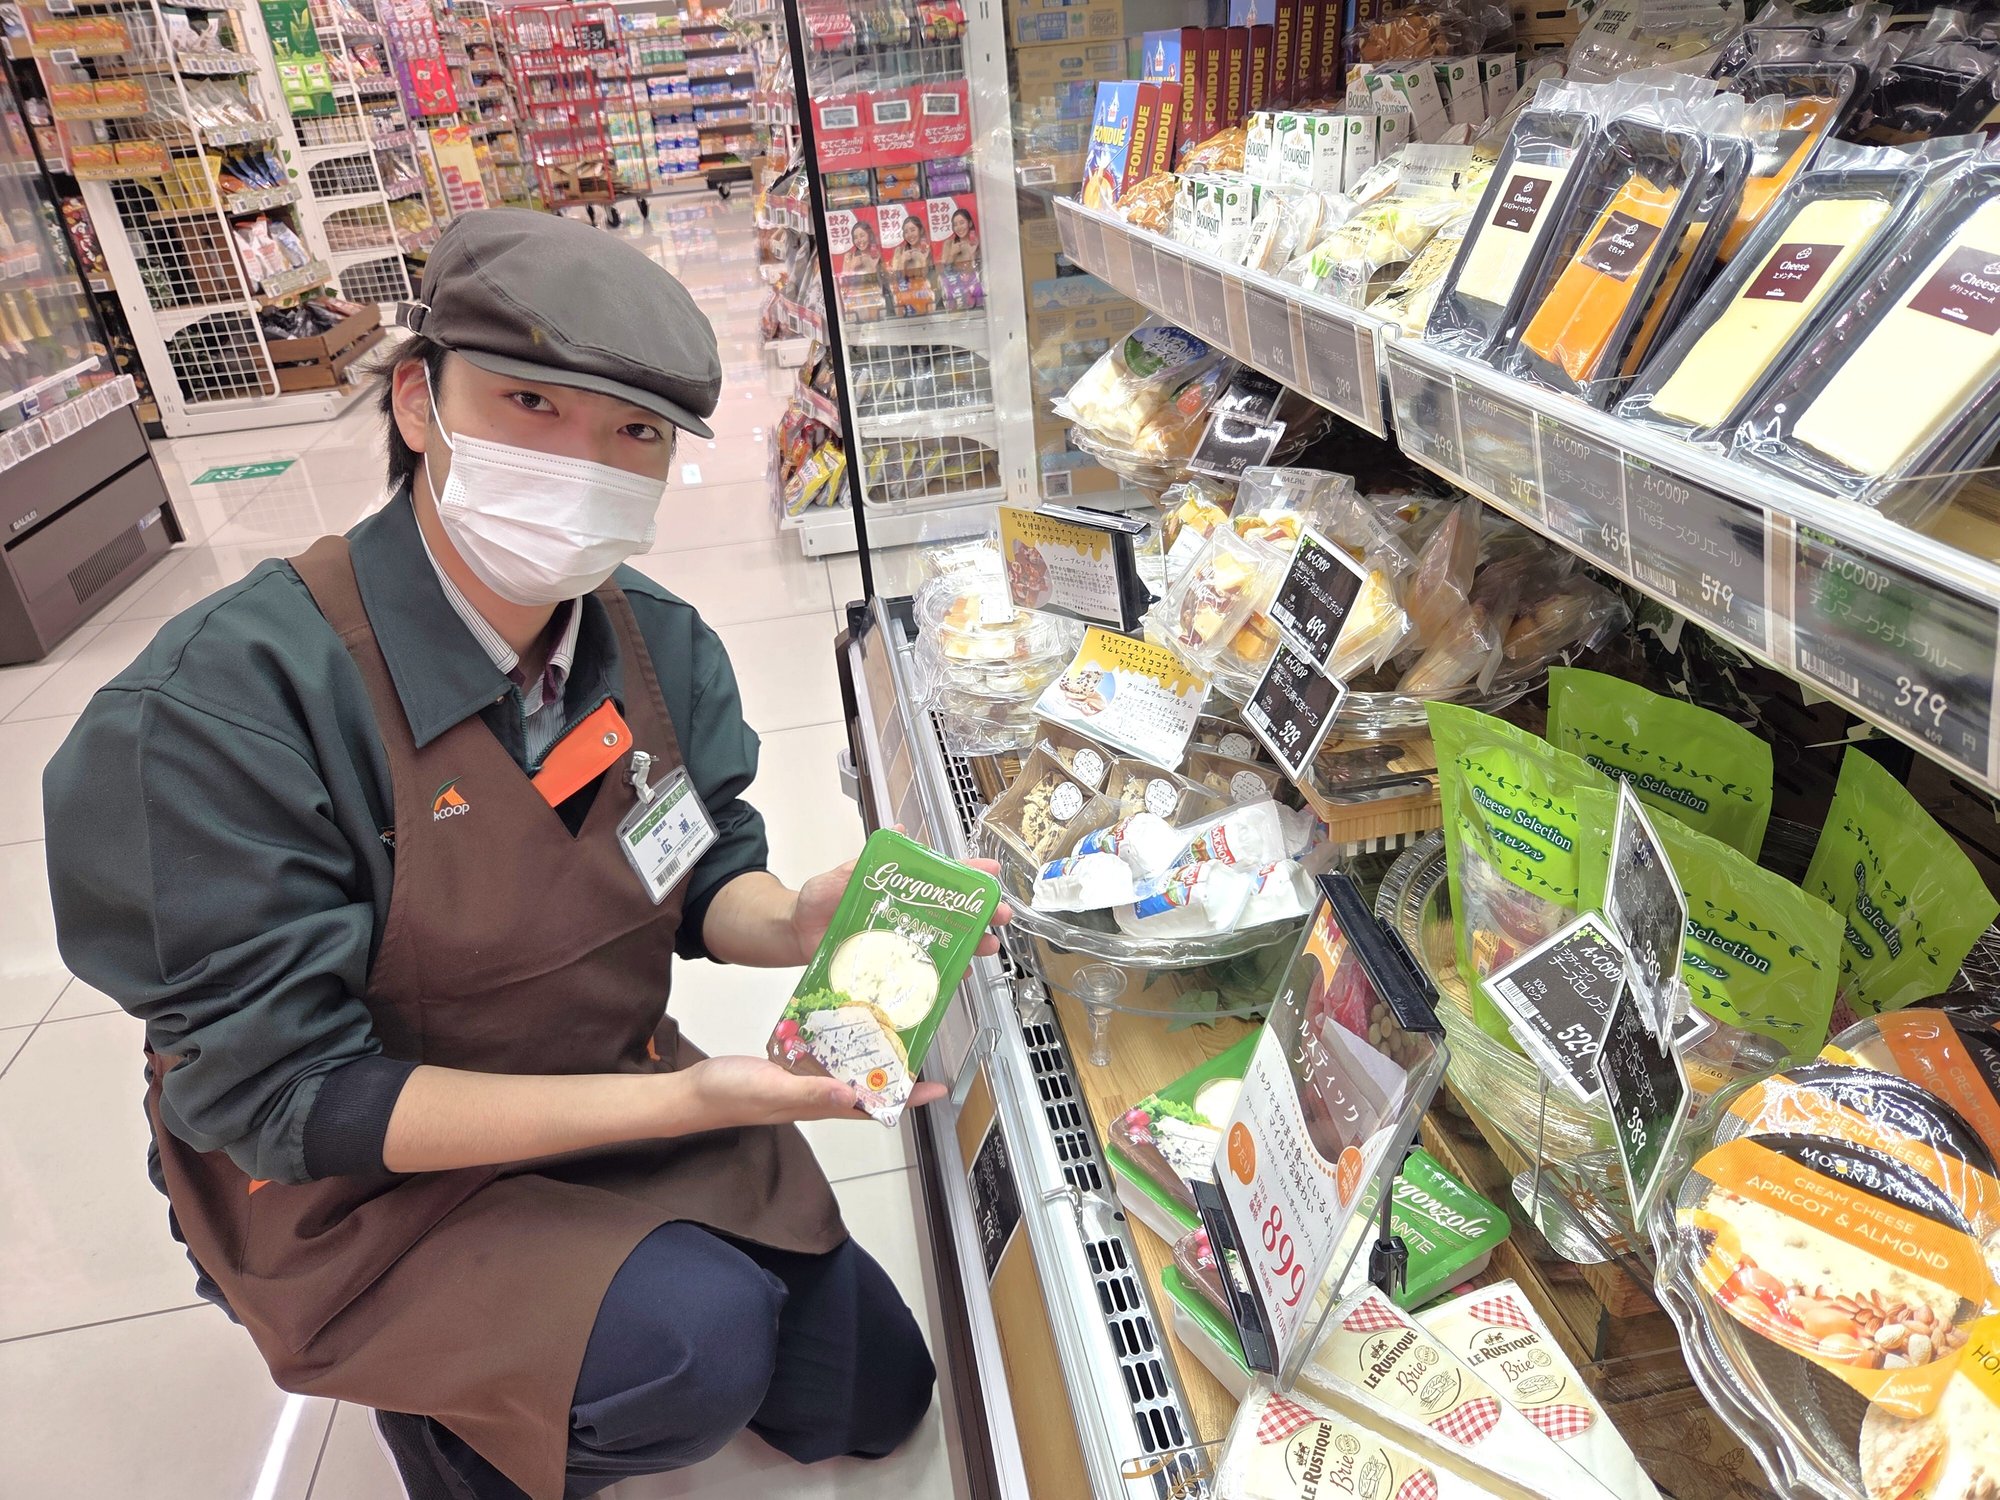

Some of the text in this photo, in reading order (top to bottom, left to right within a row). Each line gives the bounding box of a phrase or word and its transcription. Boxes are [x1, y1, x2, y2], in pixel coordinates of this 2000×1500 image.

[1275, 7, 1291, 81] FONDUE
[1299, 5, 1315, 80] FONDUE
[1320, 3, 1337, 78] FONDUE
[1182, 49, 1196, 123] FONDUE
[1205, 49, 1220, 121] FONDUE
[1227, 48, 1242, 121] FONDUE
[1251, 47, 1265, 110] ONDUE
[1093, 125, 1126, 146] FONDUE
[1128, 105, 1151, 176] FONDUE
[1152, 102, 1173, 173] FONDUE
[828, 215, 849, 226] 飲み
[880, 209, 900, 220] 飲み
[930, 202, 950, 212] 飲み
[931, 214, 950, 226] きり
[1514, 193, 1533, 205] Cheese
[830, 226, 849, 238] きり
[881, 221, 900, 231] きり
[1612, 234, 1635, 250] Cheese
[1780, 260, 1810, 272] Cheese
[1227, 456, 1247, 470] 329
[1434, 433, 1454, 460] 499
[1601, 522, 1628, 558] 459
[1306, 615, 1328, 653] 499 円
[1747, 615, 1758, 631] 円
[1809, 587, 1963, 671] デンマークダナブルー
[1118, 658, 1168, 681] クリームチーズ
[1894, 675, 1976, 751] 379 円
[1279, 719, 1302, 761] 329 円
[1585, 755, 1708, 814] Cheese Selection
[630, 805, 665, 844] ファーマーズ
[1472, 786, 1573, 852] Cheese Selection
[660, 837, 673, 855] 広
[1504, 836, 1545, 862] セレクション
[863, 861, 987, 915] Gorgonzola
[870, 899, 954, 949] PICCANTE
[1313, 916, 1343, 968] SALE
[1686, 920, 1770, 973] Selection
[1858, 895, 1902, 958] Selection
[1642, 939, 1662, 980] 389
[1532, 977, 1548, 995] 100g
[1283, 988, 1360, 1123] ル・ルスティック
[1556, 1023, 1600, 1060] 529
[1294, 1046, 1323, 1100] ブリー
[1950, 1064, 1975, 1110] CREAM
[1233, 1129, 1251, 1176] 今だけ
[1626, 1105, 1648, 1156] 389
[1821, 1104, 1934, 1172] CREAM CHEESE
[1269, 1114, 1314, 1214] マイルドな味わい
[1393, 1175, 1492, 1243] rgonzola
[1745, 1174, 1950, 1271] APRICOT & ALMOND
[1793, 1176, 1917, 1236] CREAM CHEESE
[1262, 1204, 1307, 1307] 899
[1363, 1329, 1420, 1391] LE RUSTIQUE
[1466, 1333, 1540, 1368] LE RUSTIQUE
[1500, 1358, 1536, 1384] Brie
[1395, 1359, 1428, 1397] Brie
[1301, 1421, 1334, 1500] LE RUSTIQUE
[1328, 1453, 1356, 1497] Brie
